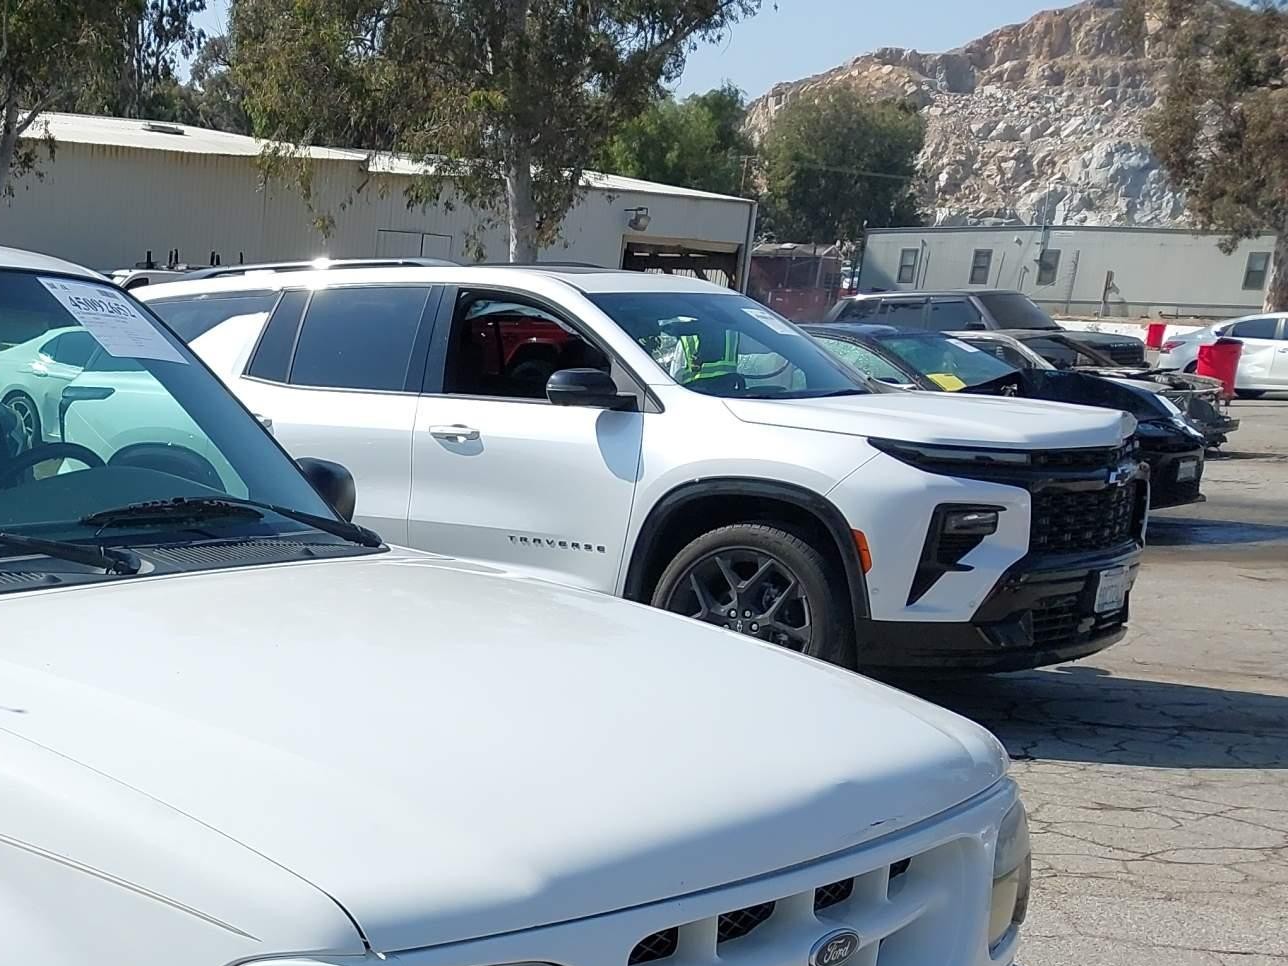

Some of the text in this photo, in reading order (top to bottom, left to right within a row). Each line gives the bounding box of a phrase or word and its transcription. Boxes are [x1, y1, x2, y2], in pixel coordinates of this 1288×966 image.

[68, 295, 136, 319] 45092652
[507, 534, 606, 553] TRAVERSE
[824, 939, 851, 963] Ford
